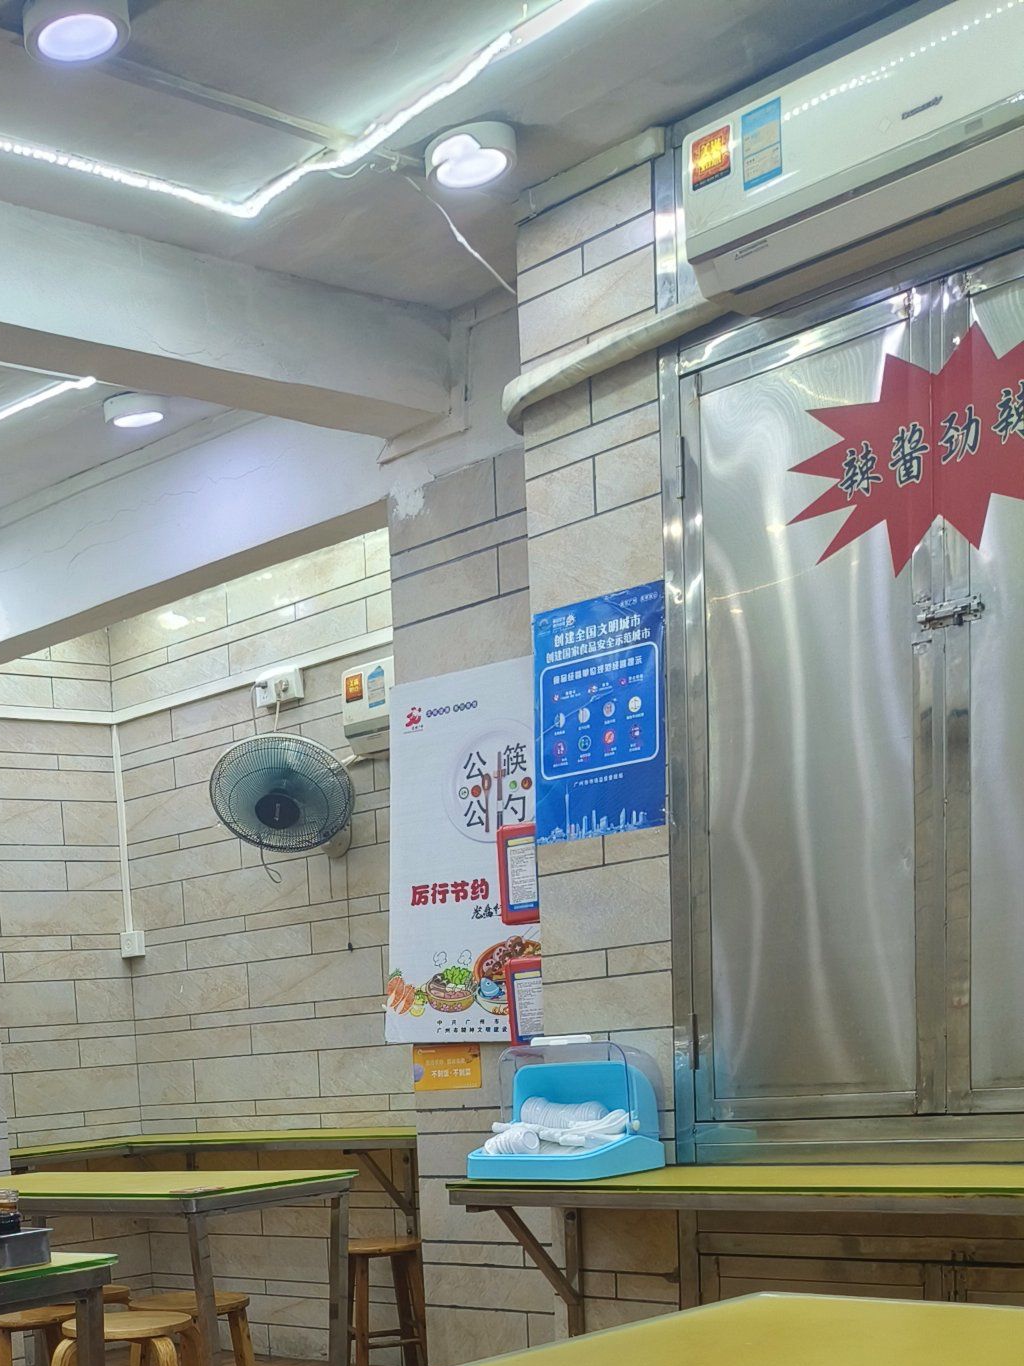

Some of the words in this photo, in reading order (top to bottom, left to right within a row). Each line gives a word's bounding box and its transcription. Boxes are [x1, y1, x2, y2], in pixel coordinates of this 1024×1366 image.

[546, 628, 651, 663] 创建国家食品安全示范城市
[554, 613, 641, 648] 创建全国文明城市
[410, 878, 490, 906] 厉行节约
